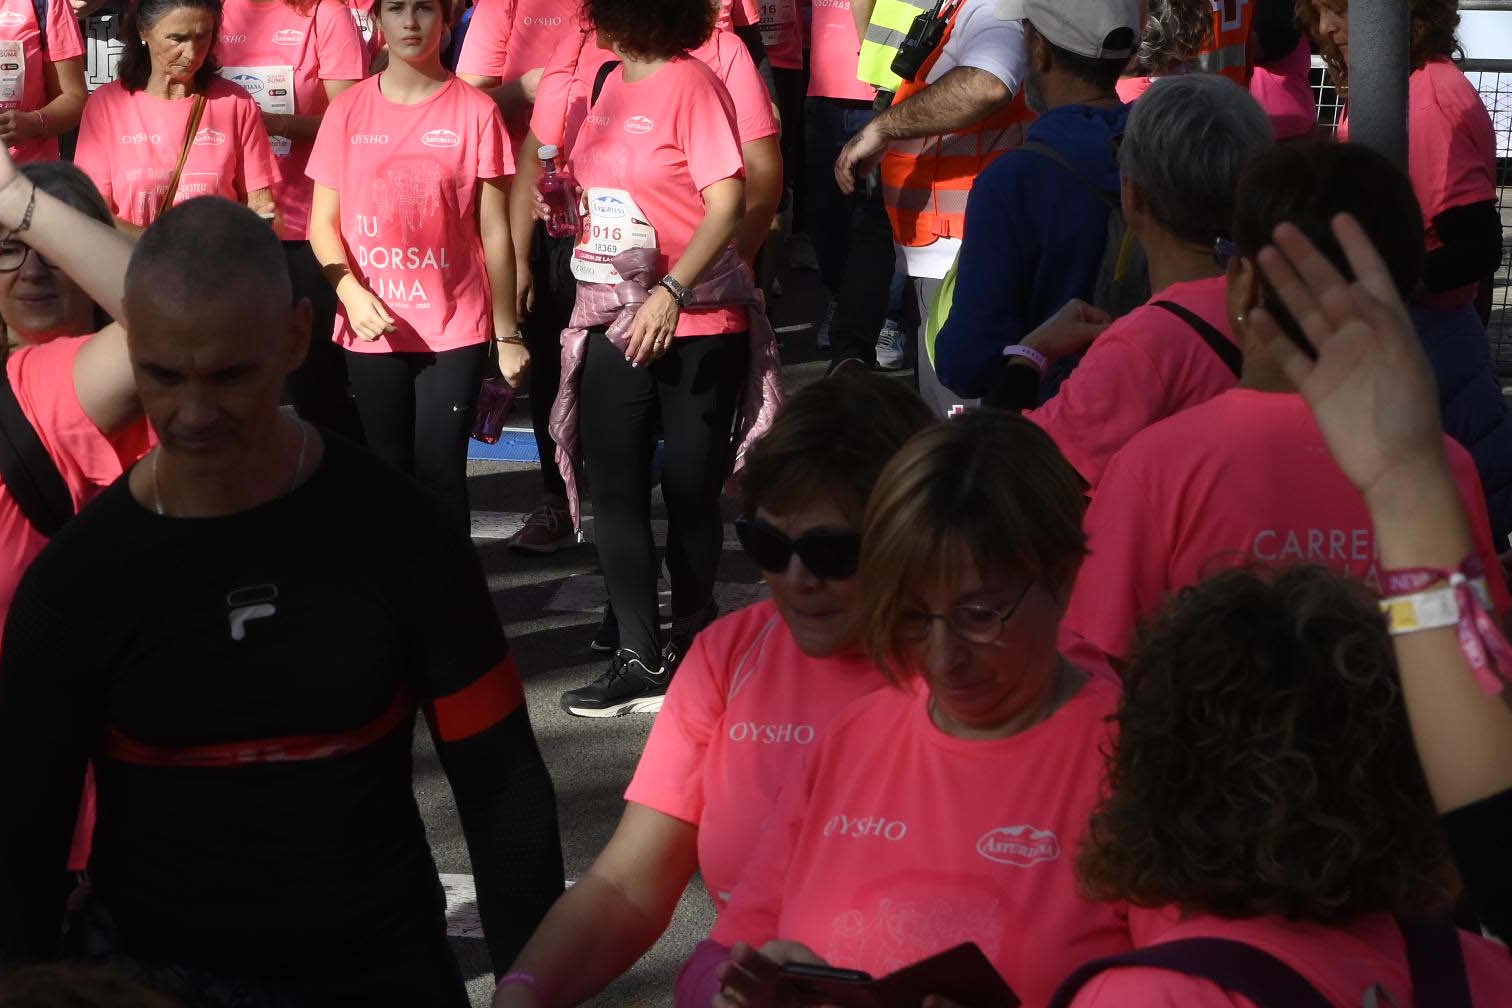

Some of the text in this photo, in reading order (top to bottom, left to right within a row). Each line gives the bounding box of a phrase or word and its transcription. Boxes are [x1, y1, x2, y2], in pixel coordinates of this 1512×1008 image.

[761, 4, 777, 15] 16
[351, 134, 389, 144] OYSHO
[357, 214, 378, 237] TU
[593, 225, 622, 241] 016
[359, 246, 450, 270] DORSAL
[595, 243, 617, 253] 18369
[369, 278, 428, 301] UMA
[1253, 528, 1379, 561] CARRE
[729, 722, 815, 744] OYSHO
[824, 815, 908, 842] OYSHO
